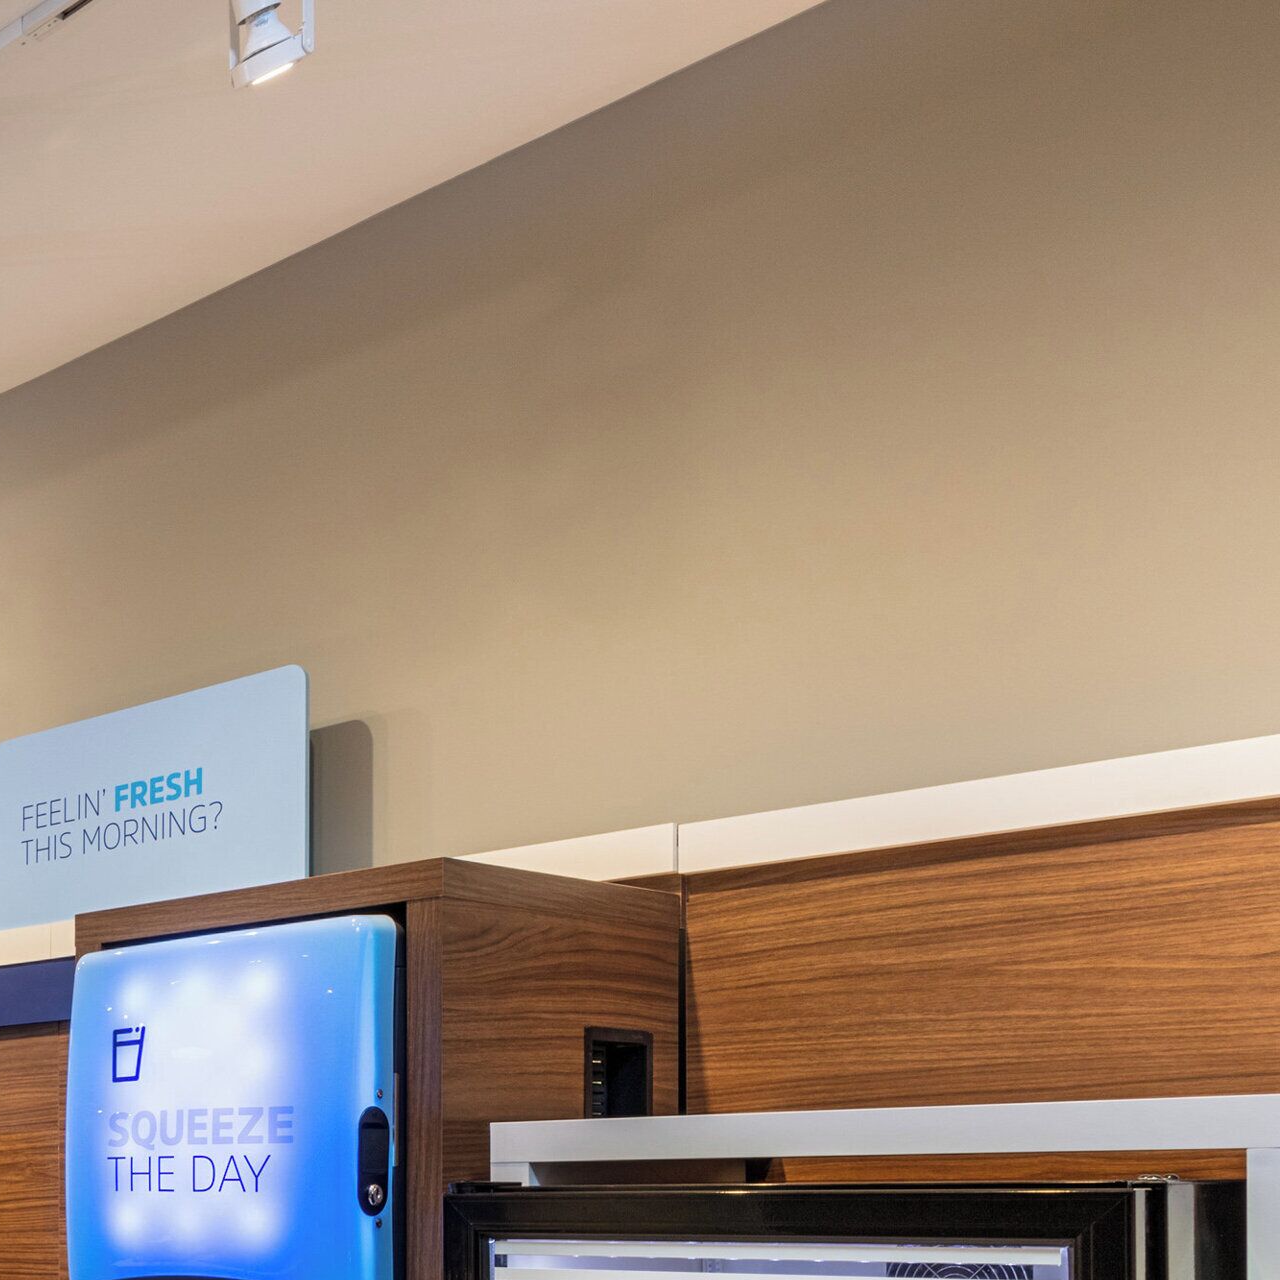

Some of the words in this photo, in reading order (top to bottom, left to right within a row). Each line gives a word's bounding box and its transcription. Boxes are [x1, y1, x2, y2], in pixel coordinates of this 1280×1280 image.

[114, 767, 203, 812] FRESH
[21, 831, 72, 865] THIS
[82, 801, 223, 854] MORNING?
[107, 1106, 295, 1151] SQUEEZE
[107, 1155, 175, 1192] THE
[192, 1154, 272, 1193] DAY
